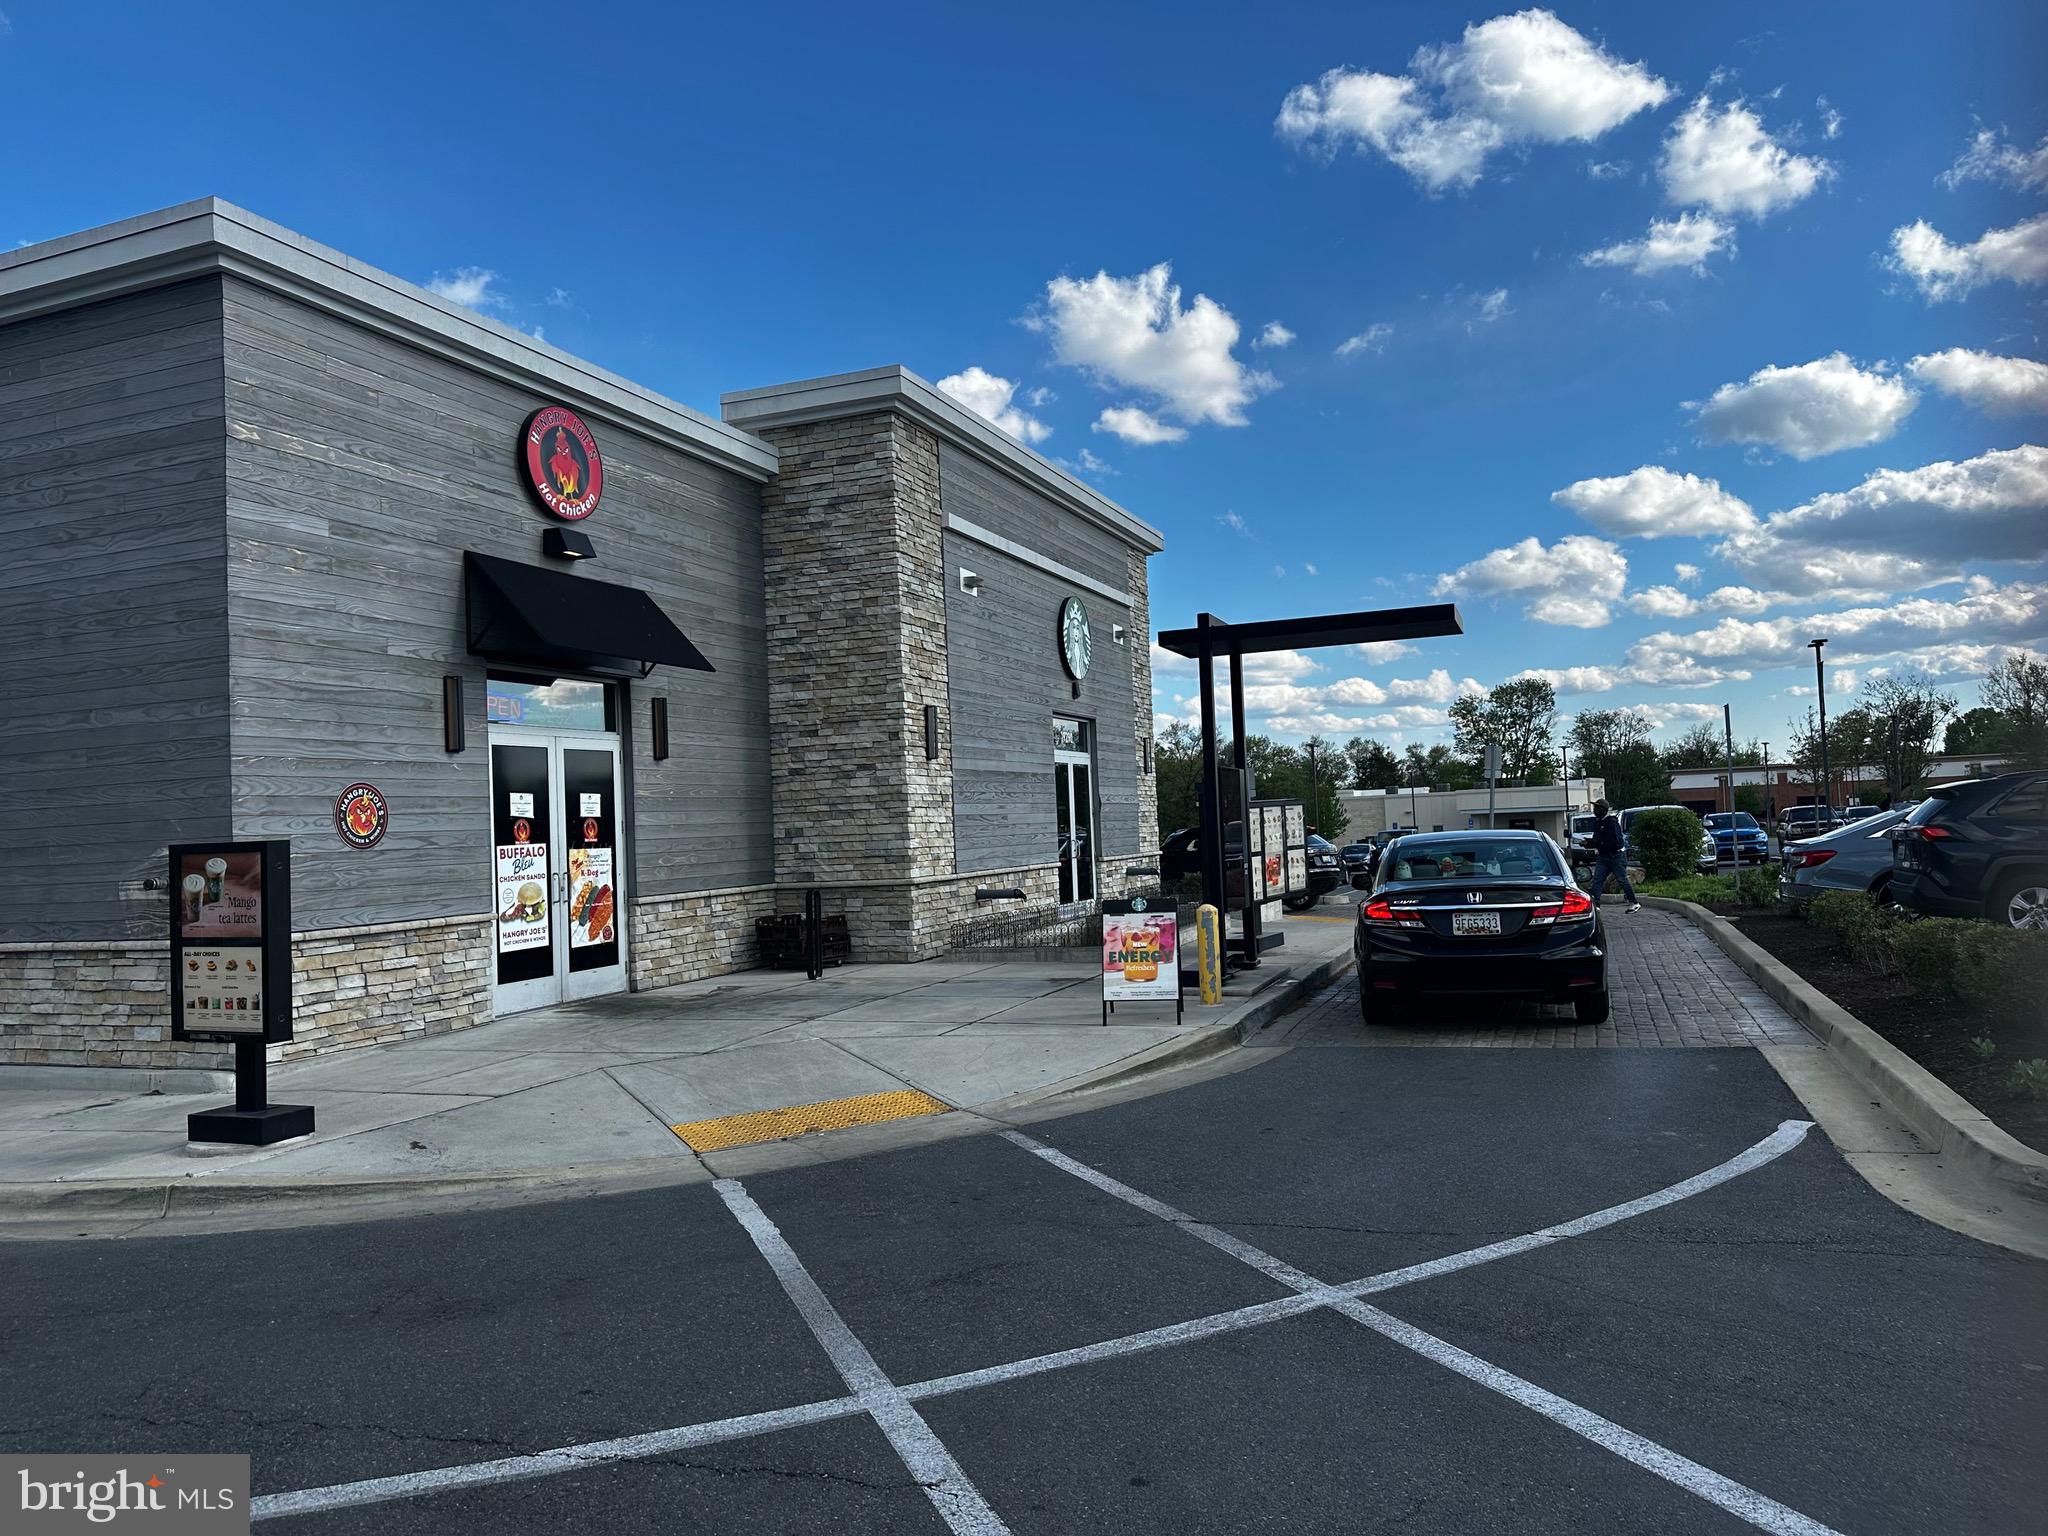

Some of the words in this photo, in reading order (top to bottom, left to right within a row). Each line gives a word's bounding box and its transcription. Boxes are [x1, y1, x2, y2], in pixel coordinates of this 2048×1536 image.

[531, 411, 568, 445] HANGRY
[539, 482, 557, 507] Hot
[559, 493, 596, 516] Chicken
[487, 696, 521, 719] PEN
[340, 788, 369, 812] HANGRY
[499, 846, 545, 860] BUFFALO
[499, 875, 526, 883] CHICKEN
[526, 873, 546, 881] SANDO
[228, 896, 256, 910] Mango
[219, 914, 231, 924] tea
[233, 912, 257, 924] lattes
[502, 929, 528, 939] HANGRY
[528, 926, 546, 936] JOE'S
[1109, 951, 1172, 963] ENERGY
